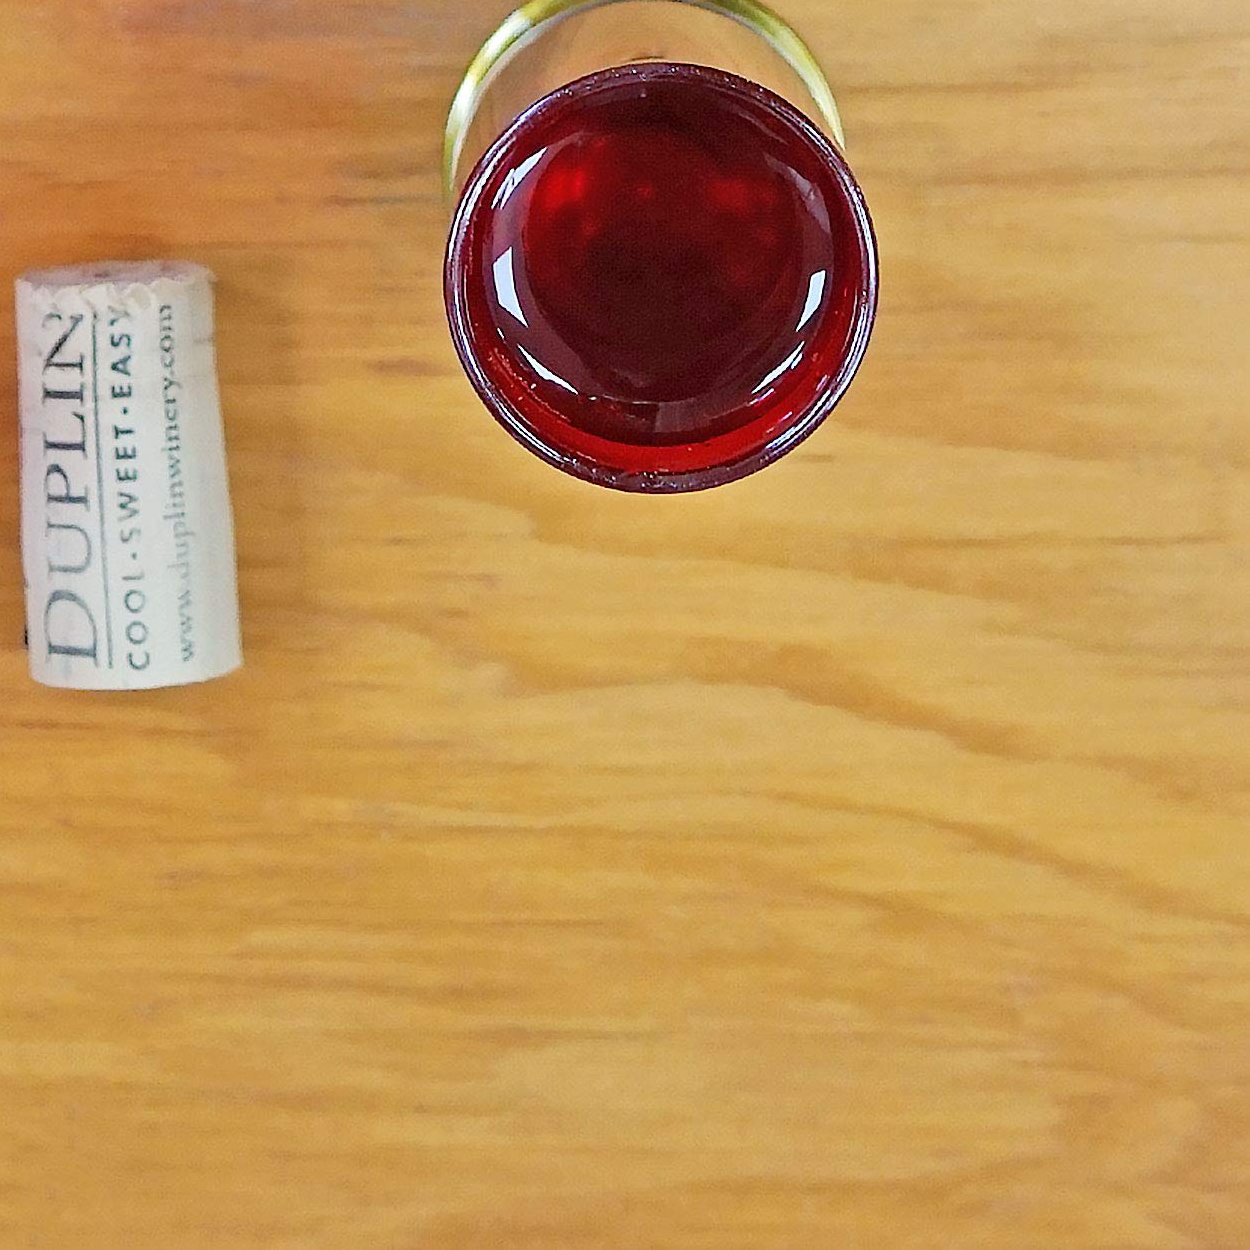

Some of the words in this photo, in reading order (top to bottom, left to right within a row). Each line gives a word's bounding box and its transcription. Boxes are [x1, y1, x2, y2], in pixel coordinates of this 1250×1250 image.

[107, 305, 135, 400] EASY
[42, 312, 100, 668] DUPLIN
[112, 422, 143, 546] SWEET
[121, 572, 151, 672] COOL
